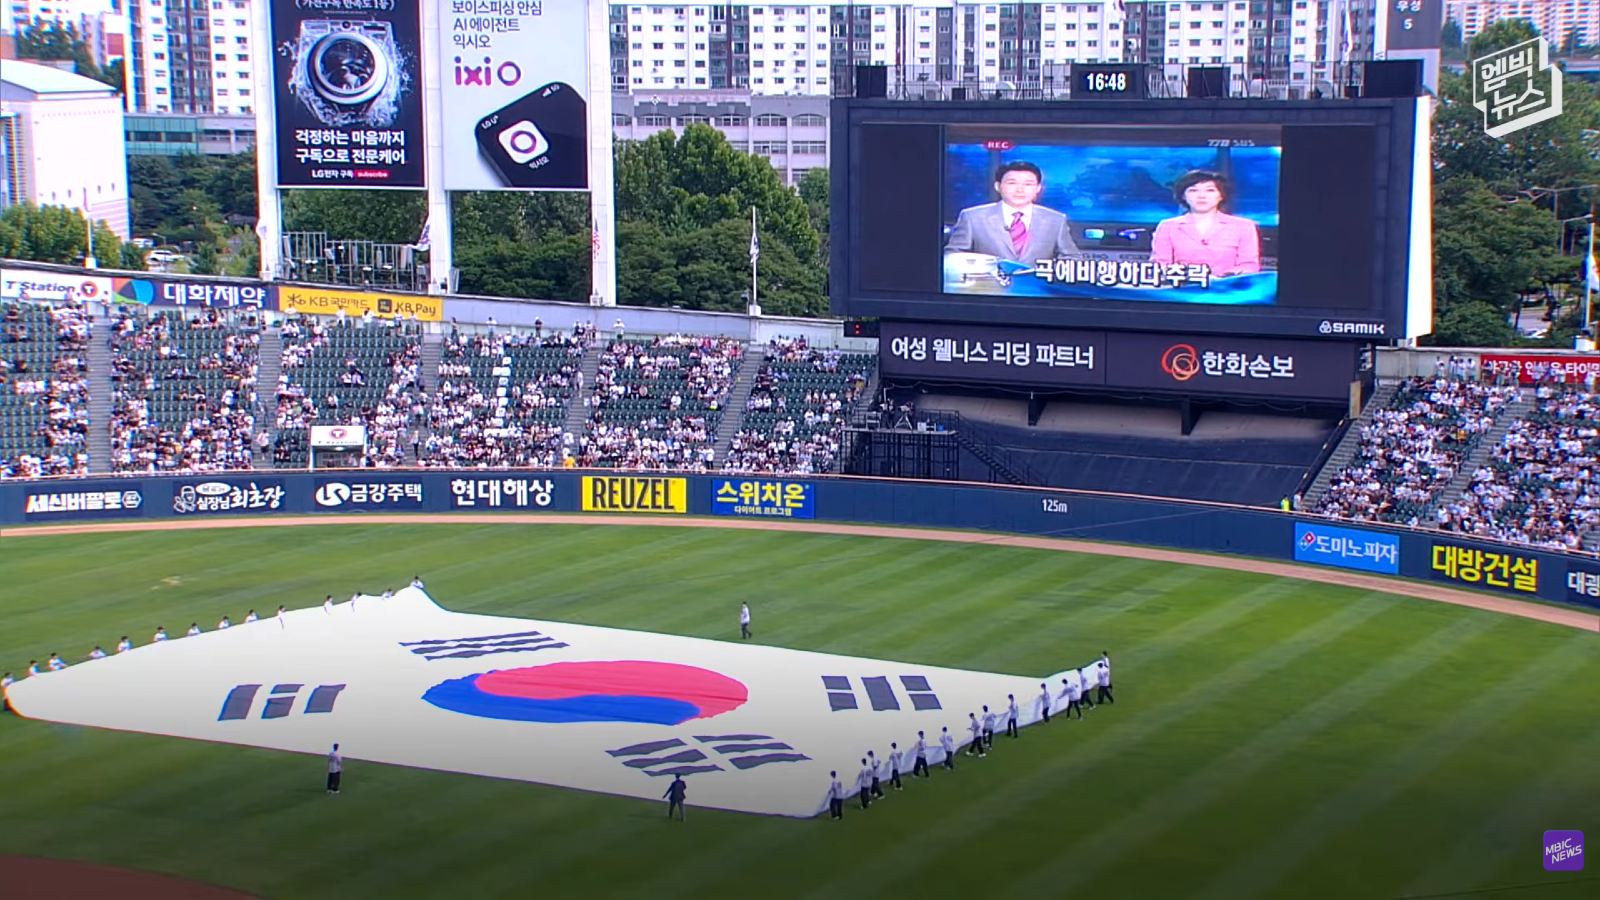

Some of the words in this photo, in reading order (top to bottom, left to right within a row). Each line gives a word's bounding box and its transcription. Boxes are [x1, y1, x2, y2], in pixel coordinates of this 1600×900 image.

[452, 0, 515, 16] 보이스피싱
[517, 0, 543, 16] 안심
[453, 17, 467, 31] AI
[469, 17, 521, 32] 에이전트
[1403, 18, 1414, 30] 5
[453, 33, 492, 49] 익시오
[1087, 72, 1127, 91] 16:48
[295, 129, 350, 145] 걱정하는
[352, 130, 405, 146] 마음까지
[987, 141, 1009, 149] REC
[295, 148, 350, 163] 구독으로
[352, 148, 405, 164] 전문케어
[1035, 259, 1160, 287] 곡예비행하다
[1166, 264, 1210, 288] 추락
[163, 283, 267, 309] 대화제약
[309, 295, 329, 307] KB
[415, 303, 436, 315] Pay
[1332, 322, 1385, 335] SAMIK
[891, 336, 927, 361] 여성
[932, 338, 989, 363] 웰니스
[992, 342, 1030, 366] 리딩
[1035, 343, 1094, 370] 파트너
[1202, 351, 1295, 379] 한화손보
[25, 491, 121, 513] 세신버팔로
[229, 482, 286, 509] 회초장
[351, 483, 422, 503] 금강주택
[451, 479, 554, 506] 현대해상
[592, 477, 675, 509] REUZEL
[716, 481, 806, 508] 스위치온
[734, 505, 762, 515] 다이어트
[1042, 499, 1068, 513] 125m
[1314, 535, 1399, 565] 도미노피자
[1432, 545, 1538, 592] 대방건설
